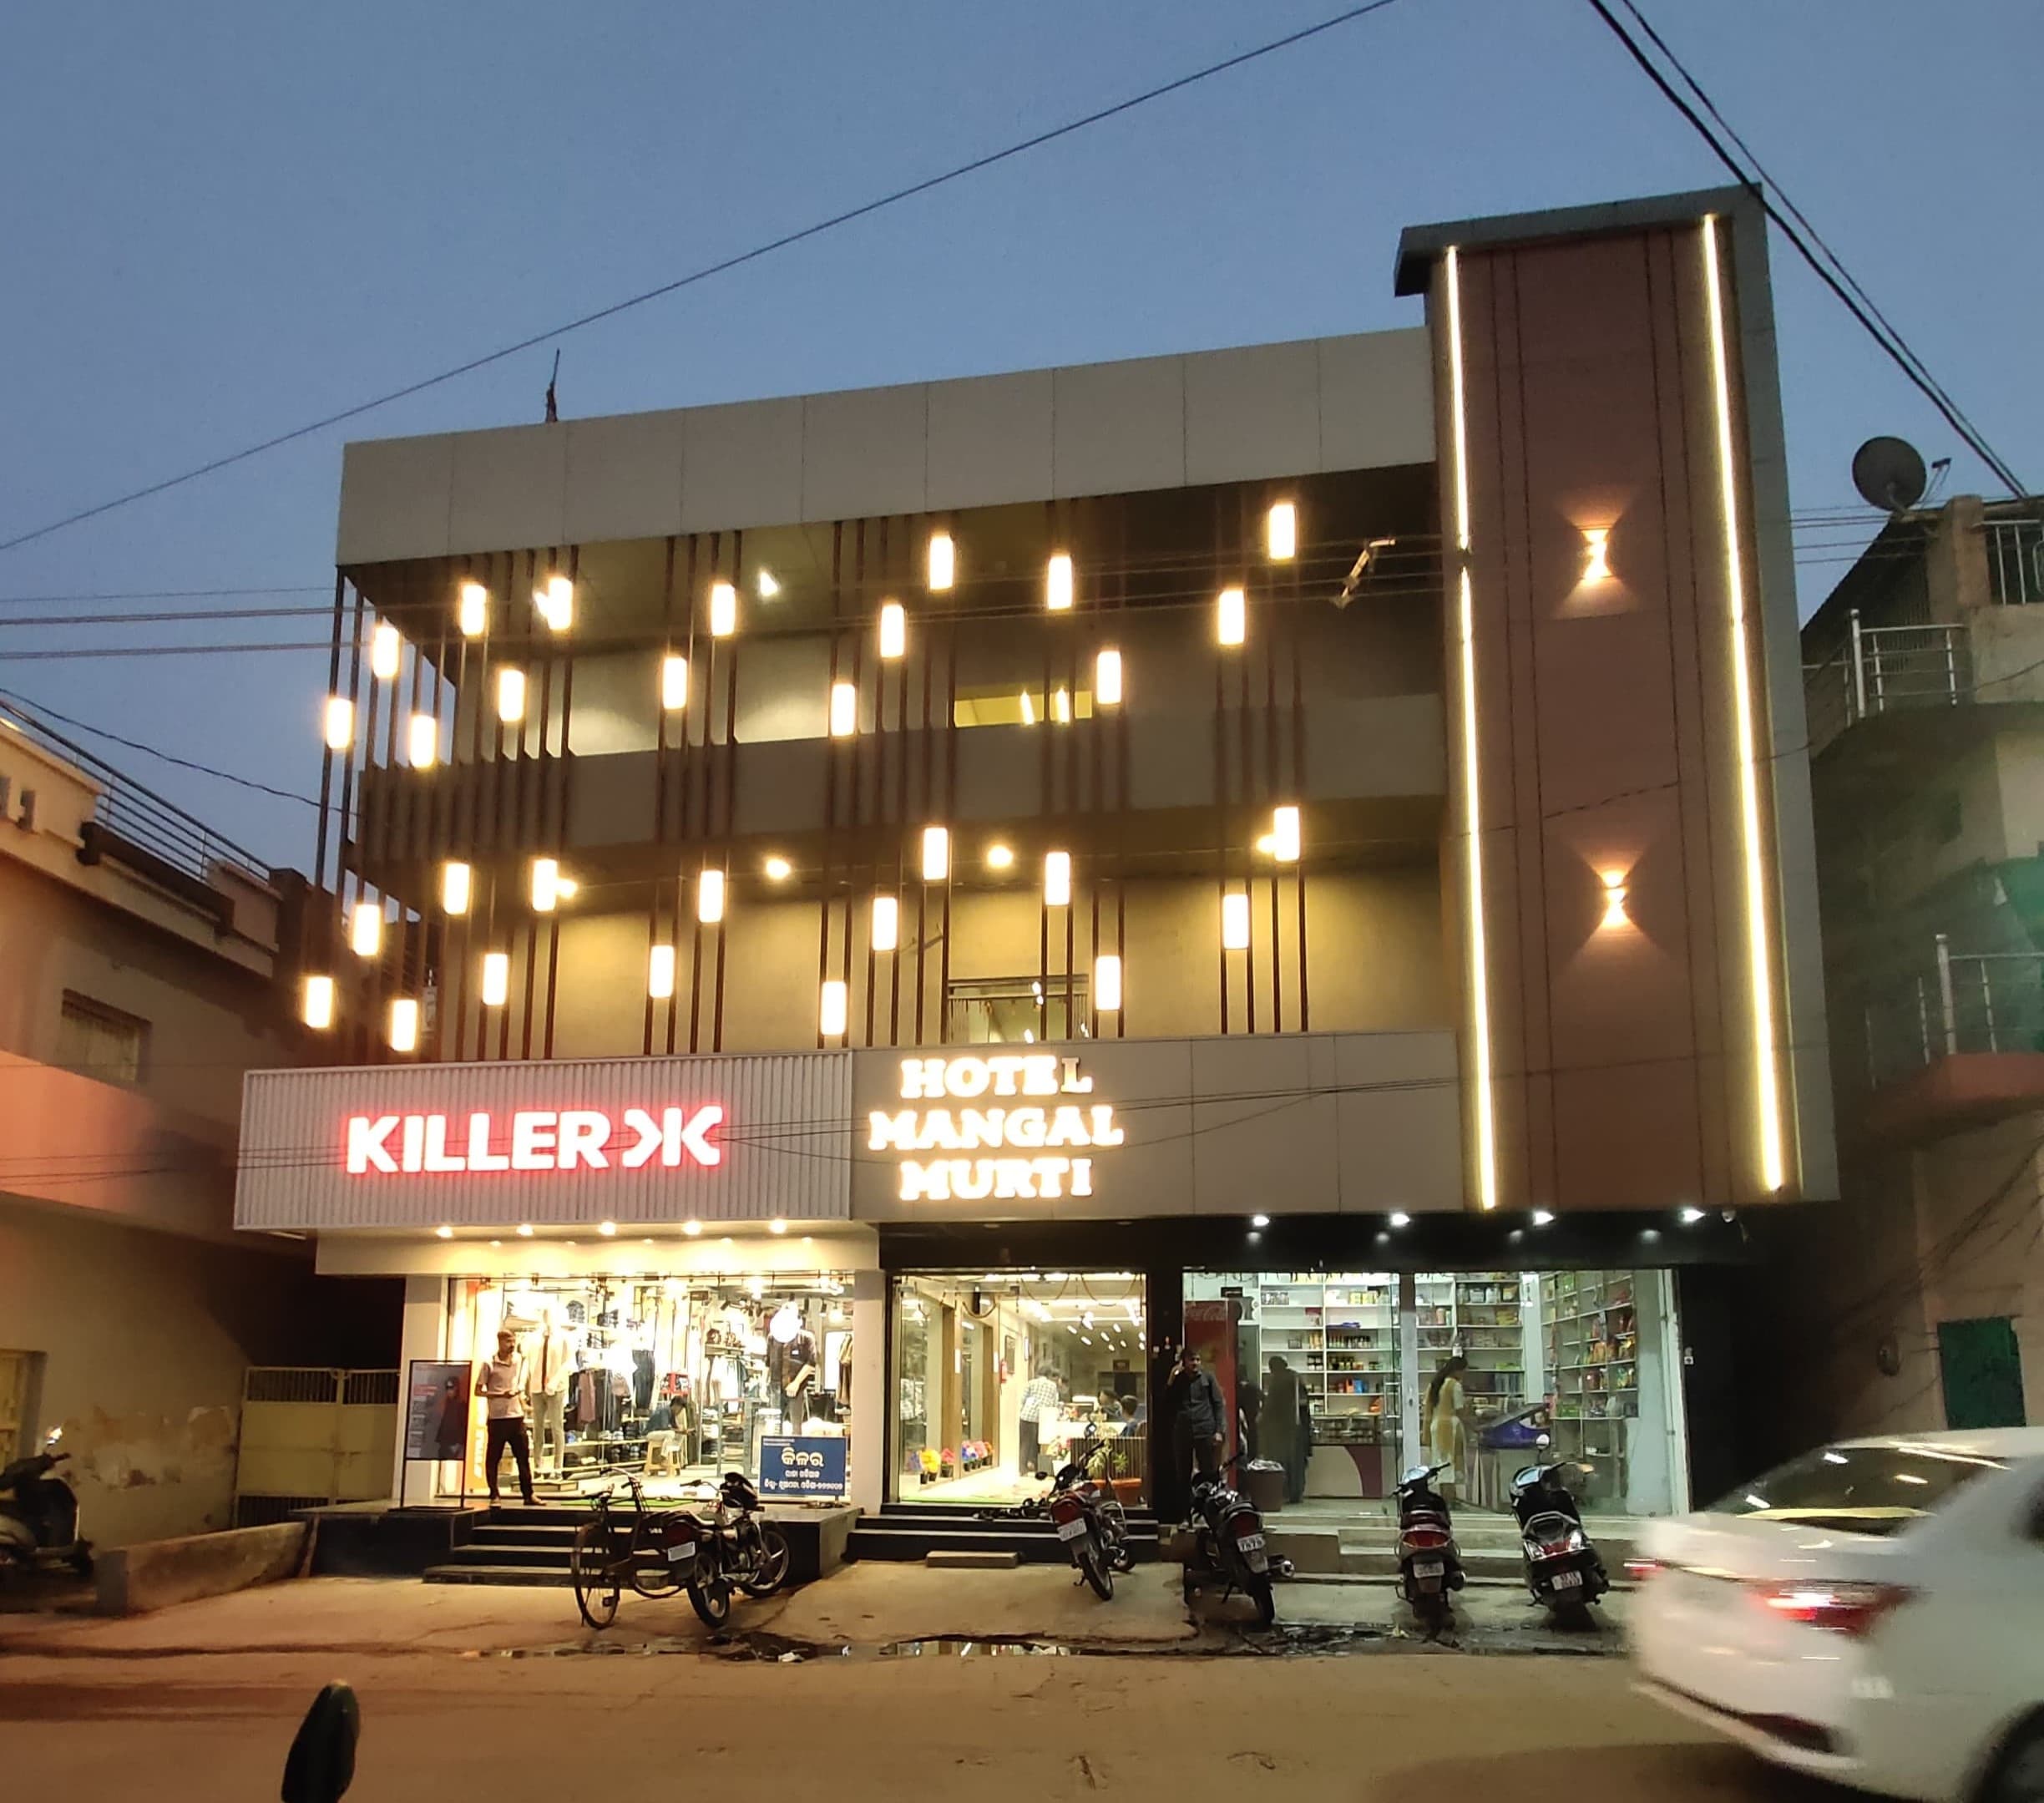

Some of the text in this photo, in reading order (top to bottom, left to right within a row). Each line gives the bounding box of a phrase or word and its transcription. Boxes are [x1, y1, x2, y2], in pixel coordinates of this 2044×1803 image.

[900, 1056, 1093, 1099] HOTEL
[347, 1110, 611, 1173] KILLER
[868, 1105, 1124, 1150] MANGAL
[899, 1157, 1093, 1200] MURTI
